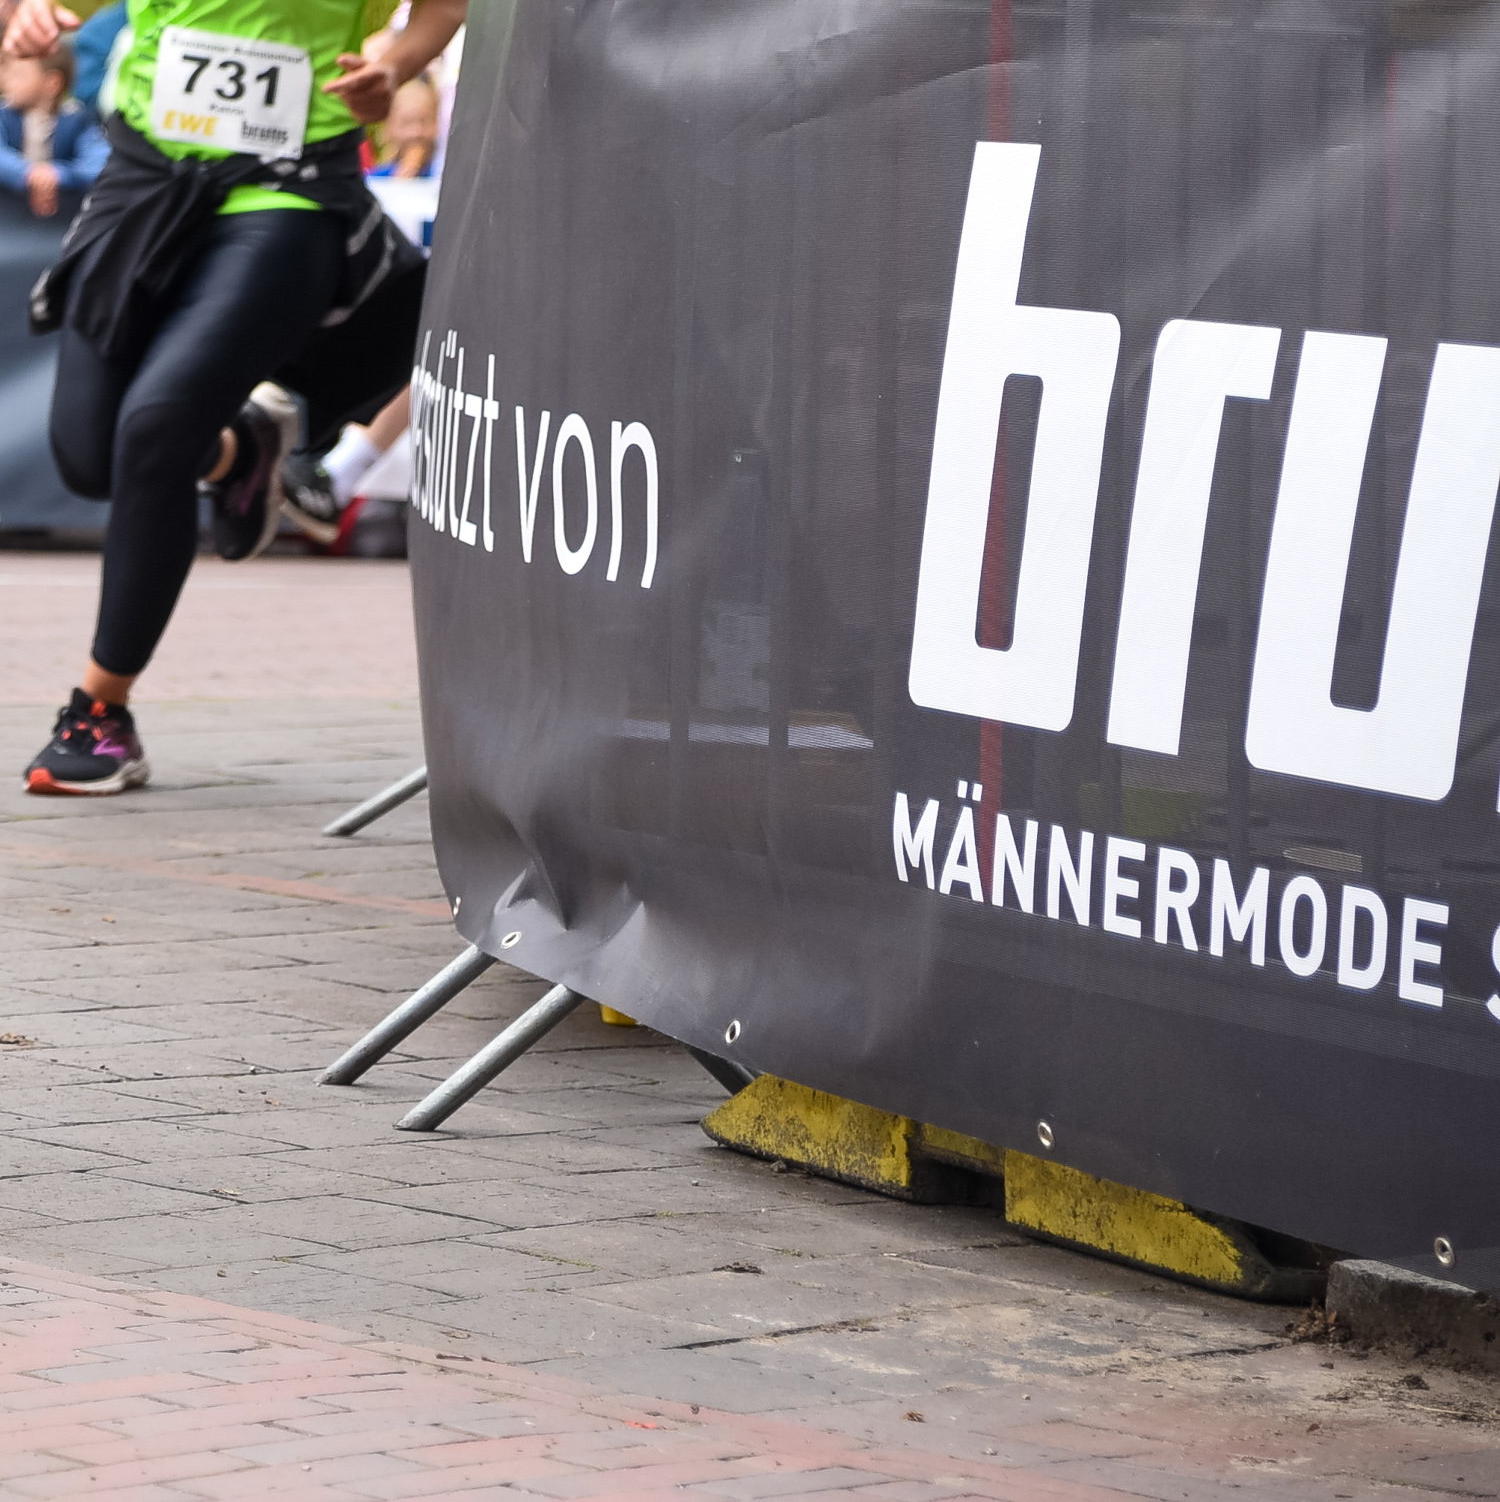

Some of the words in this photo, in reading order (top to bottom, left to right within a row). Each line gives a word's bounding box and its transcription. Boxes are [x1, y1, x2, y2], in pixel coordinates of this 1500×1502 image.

[163, 109, 218, 137] EWE
[182, 54, 280, 107] 731
[515, 405, 658, 589] von
[893, 781, 1449, 1008] MÄNNERMODE
